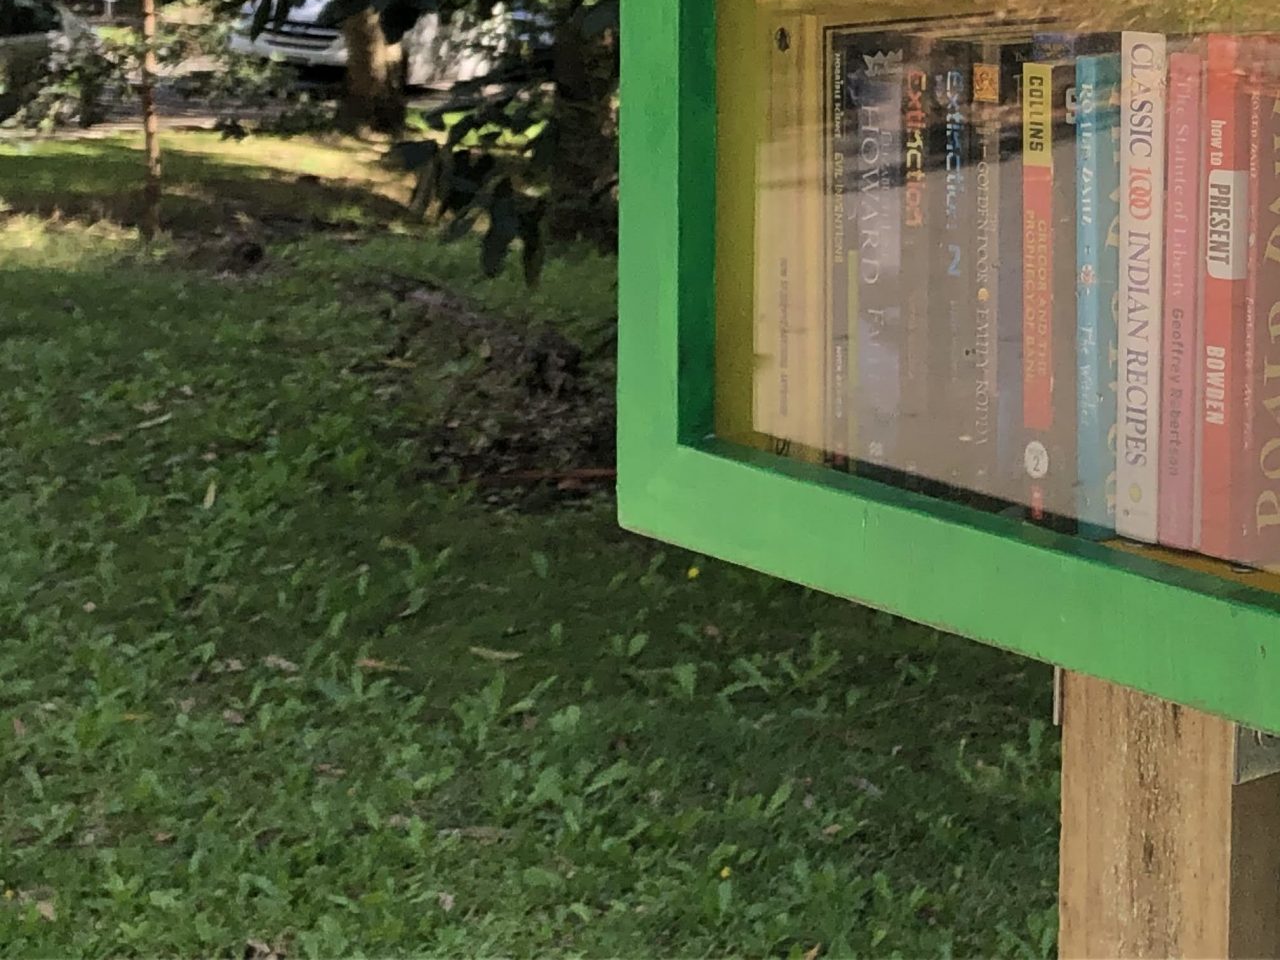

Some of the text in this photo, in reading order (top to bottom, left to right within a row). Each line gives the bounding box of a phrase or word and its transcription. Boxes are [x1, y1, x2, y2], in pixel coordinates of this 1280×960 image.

[905, 70, 927, 227] Extinction
[1028, 75, 1044, 152] COLLINS
[834, 152, 844, 263] EVIL INVENTIONS
[861, 105, 880, 284] HOWARD
[976, 161, 990, 232] GOLDEN
[1171, 80, 1190, 297] The Statute of Liberty
[1209, 119, 1231, 265] how to PRESENT
[945, 244, 962, 277] 2
[1025, 209, 1035, 301] PROPHECY
[1025, 308, 1035, 328] OF
[1037, 220, 1048, 376] GREGOR AND THE
[1124, 43, 1154, 467] CLASSIC 1000 INDIAN RECIPES
[1168, 308, 1185, 476] Geoffrey Robertson
[1205, 345, 1226, 425] BOWDEN
